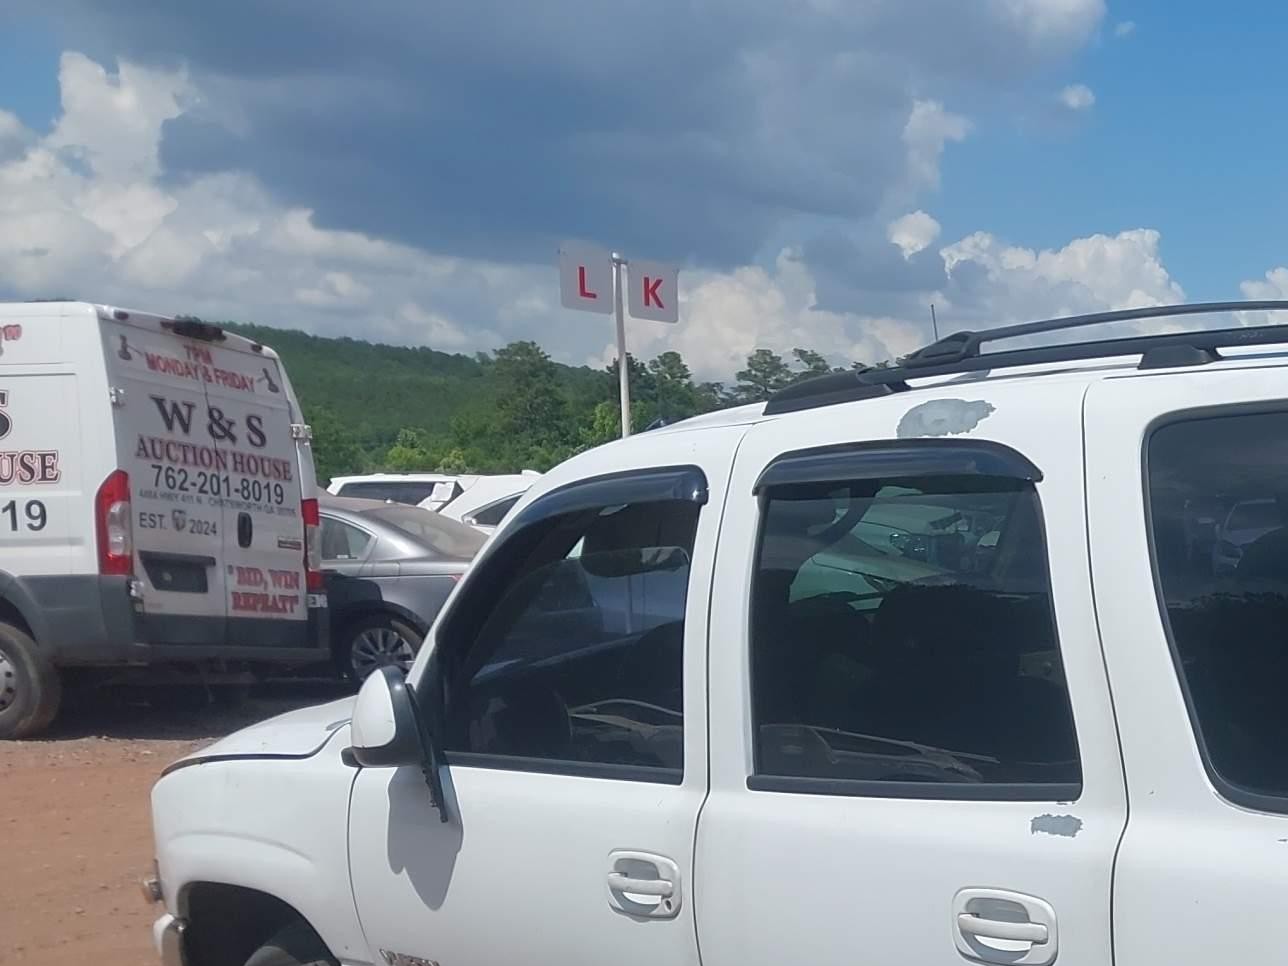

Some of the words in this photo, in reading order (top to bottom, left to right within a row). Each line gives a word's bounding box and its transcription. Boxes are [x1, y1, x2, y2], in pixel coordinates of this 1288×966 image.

[578, 266, 597, 299] L
[643, 276, 665, 309] K
[145, 352, 199, 380] MONDAY
[214, 368, 255, 392] FRIDAY
[150, 395, 196, 435] W
[208, 407, 238, 445] &
[246, 414, 267, 448] S
[135, 434, 229, 472] AUCTION
[232, 452, 293, 482] HOUSE
[151, 464, 285, 505] 762-201-8019
[139, 511, 168, 530] EST.
[189, 519, 217, 535] 2024
[268, 569, 300, 589] WIN
